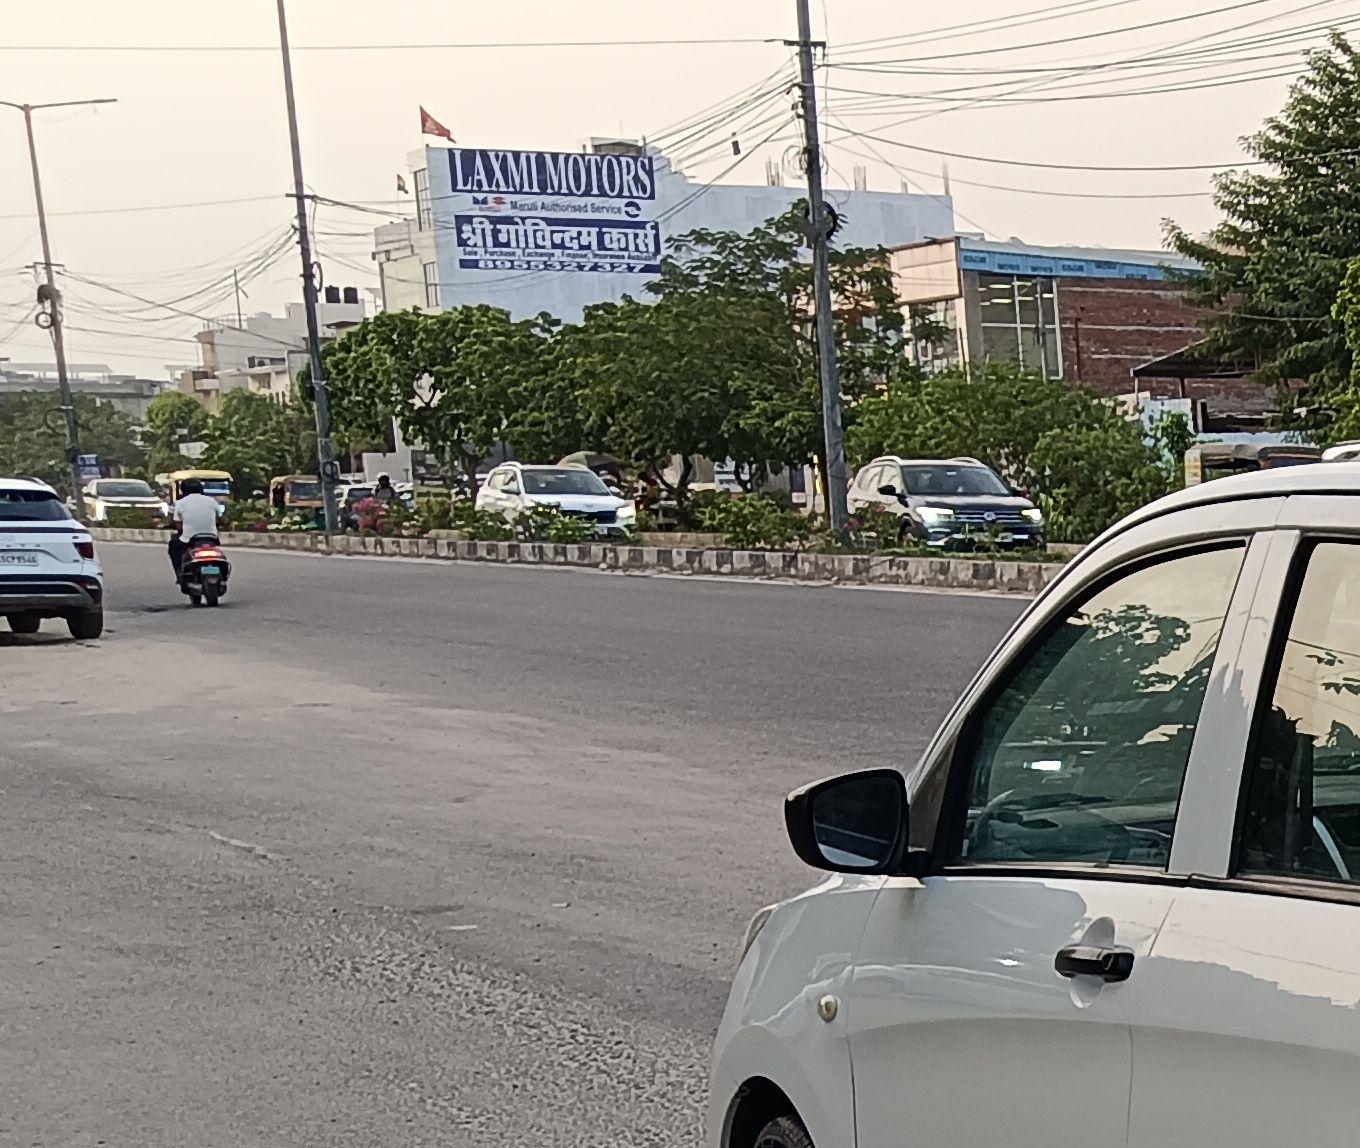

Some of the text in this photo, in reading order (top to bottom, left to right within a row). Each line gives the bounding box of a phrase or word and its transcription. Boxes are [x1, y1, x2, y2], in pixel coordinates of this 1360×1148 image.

[452, 149, 651, 200] LAXMI MOTORS
[510, 200, 538, 211] Maruti
[590, 202, 622, 215] Service
[461, 217, 494, 247] श्री
